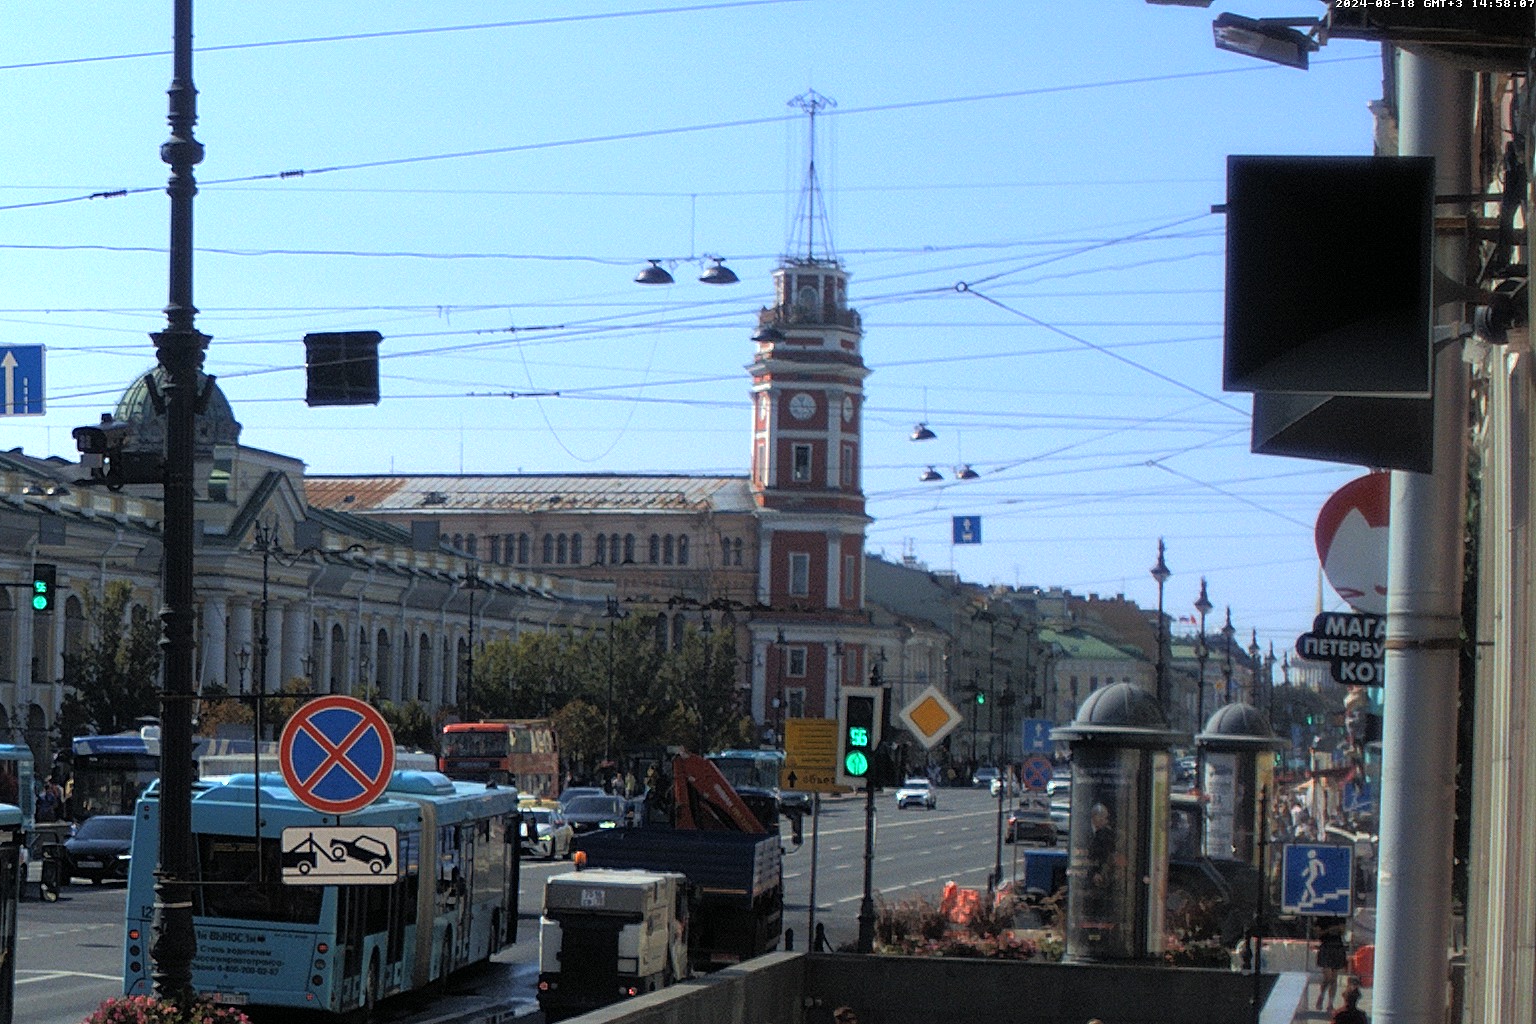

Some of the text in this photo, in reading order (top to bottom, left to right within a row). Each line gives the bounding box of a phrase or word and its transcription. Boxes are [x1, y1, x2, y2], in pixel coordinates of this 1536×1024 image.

[1325, 616, 1386, 639] МАГА
[1304, 638, 1385, 659] ПЕТЕРБУ
[1340, 661, 1385, 683] КОТ
[849, 726, 868, 747] 56
